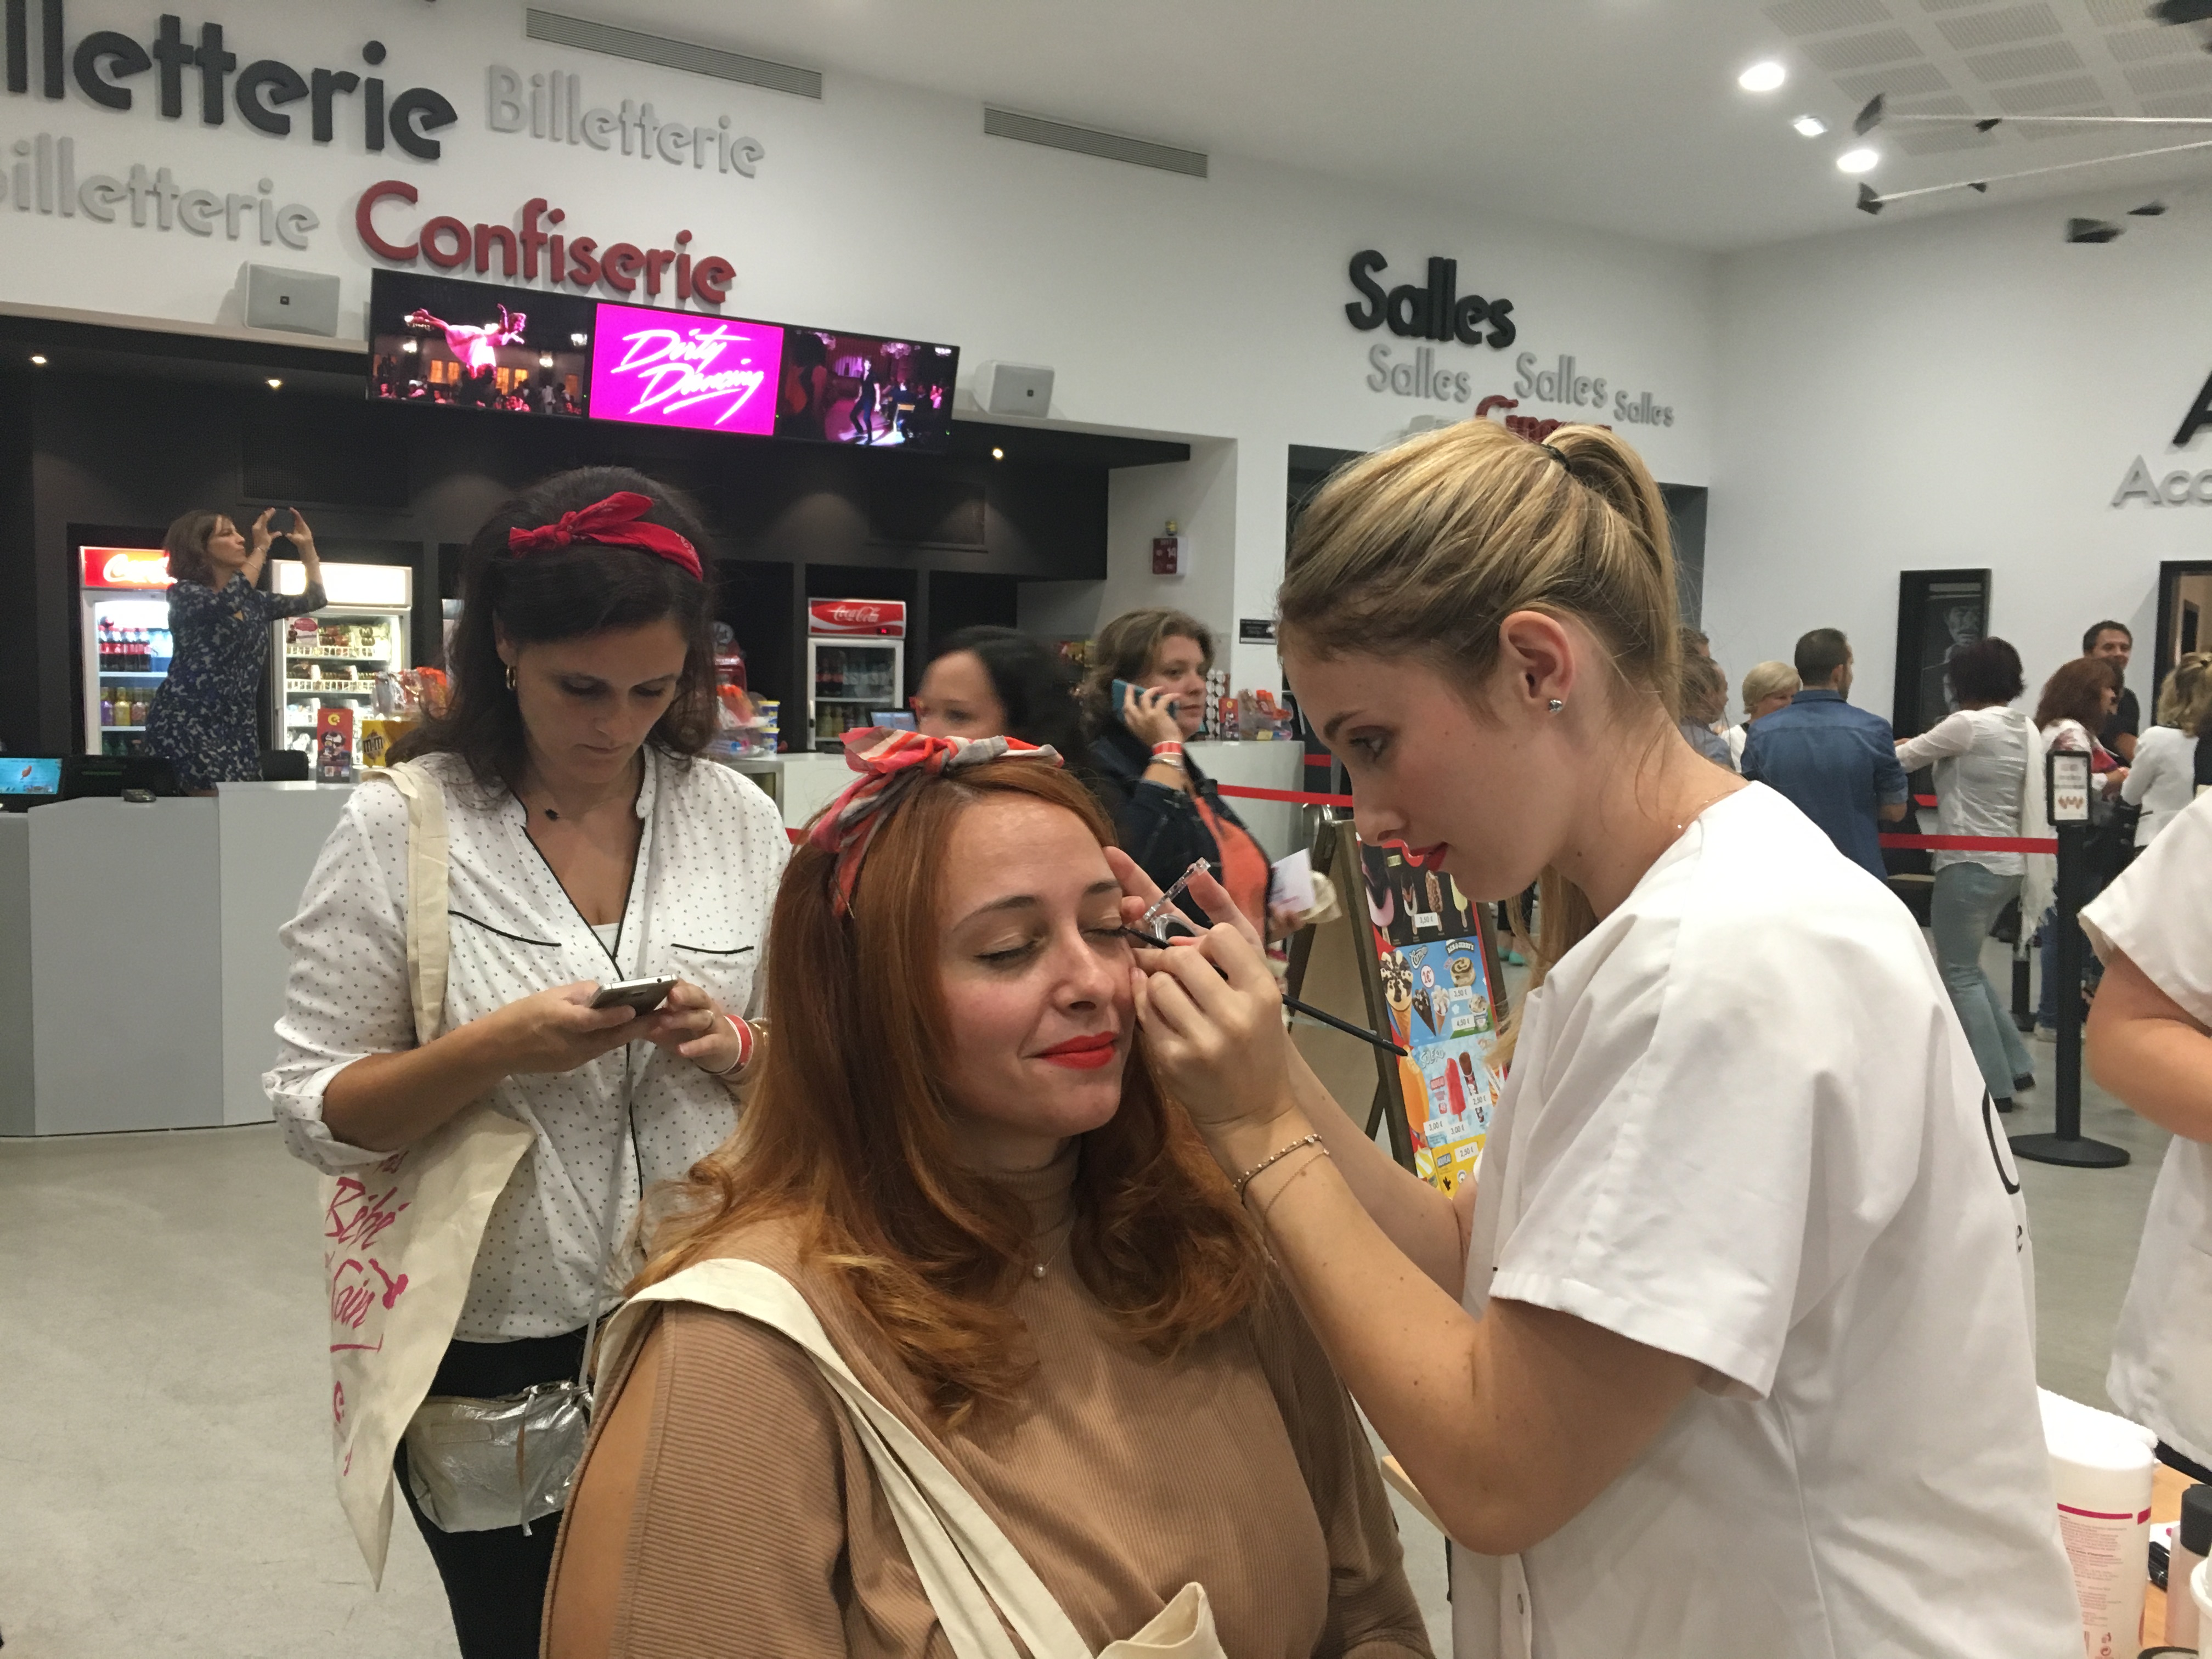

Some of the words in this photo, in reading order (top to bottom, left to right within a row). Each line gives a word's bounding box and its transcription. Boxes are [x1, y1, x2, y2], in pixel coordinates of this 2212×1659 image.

[7, 0, 458, 159] lletterie
[488, 64, 765, 177] Billetterie
[0, 133, 320, 249] illetterie
[356, 179, 736, 303] Confiserie
[1345, 250, 1516, 348] Salles
[611, 324, 751, 374] Dirty
[1367, 343, 1471, 403] Salles
[625, 358, 764, 426] Dancing
[1514, 352, 1607, 408] Salles
[1613, 390, 1674, 427] Salles
[1429, 1122, 1440, 1131] 3,00
[1451, 1125, 1461, 1135] 3,00
[1460, 1147, 1470, 1158] 2,50
